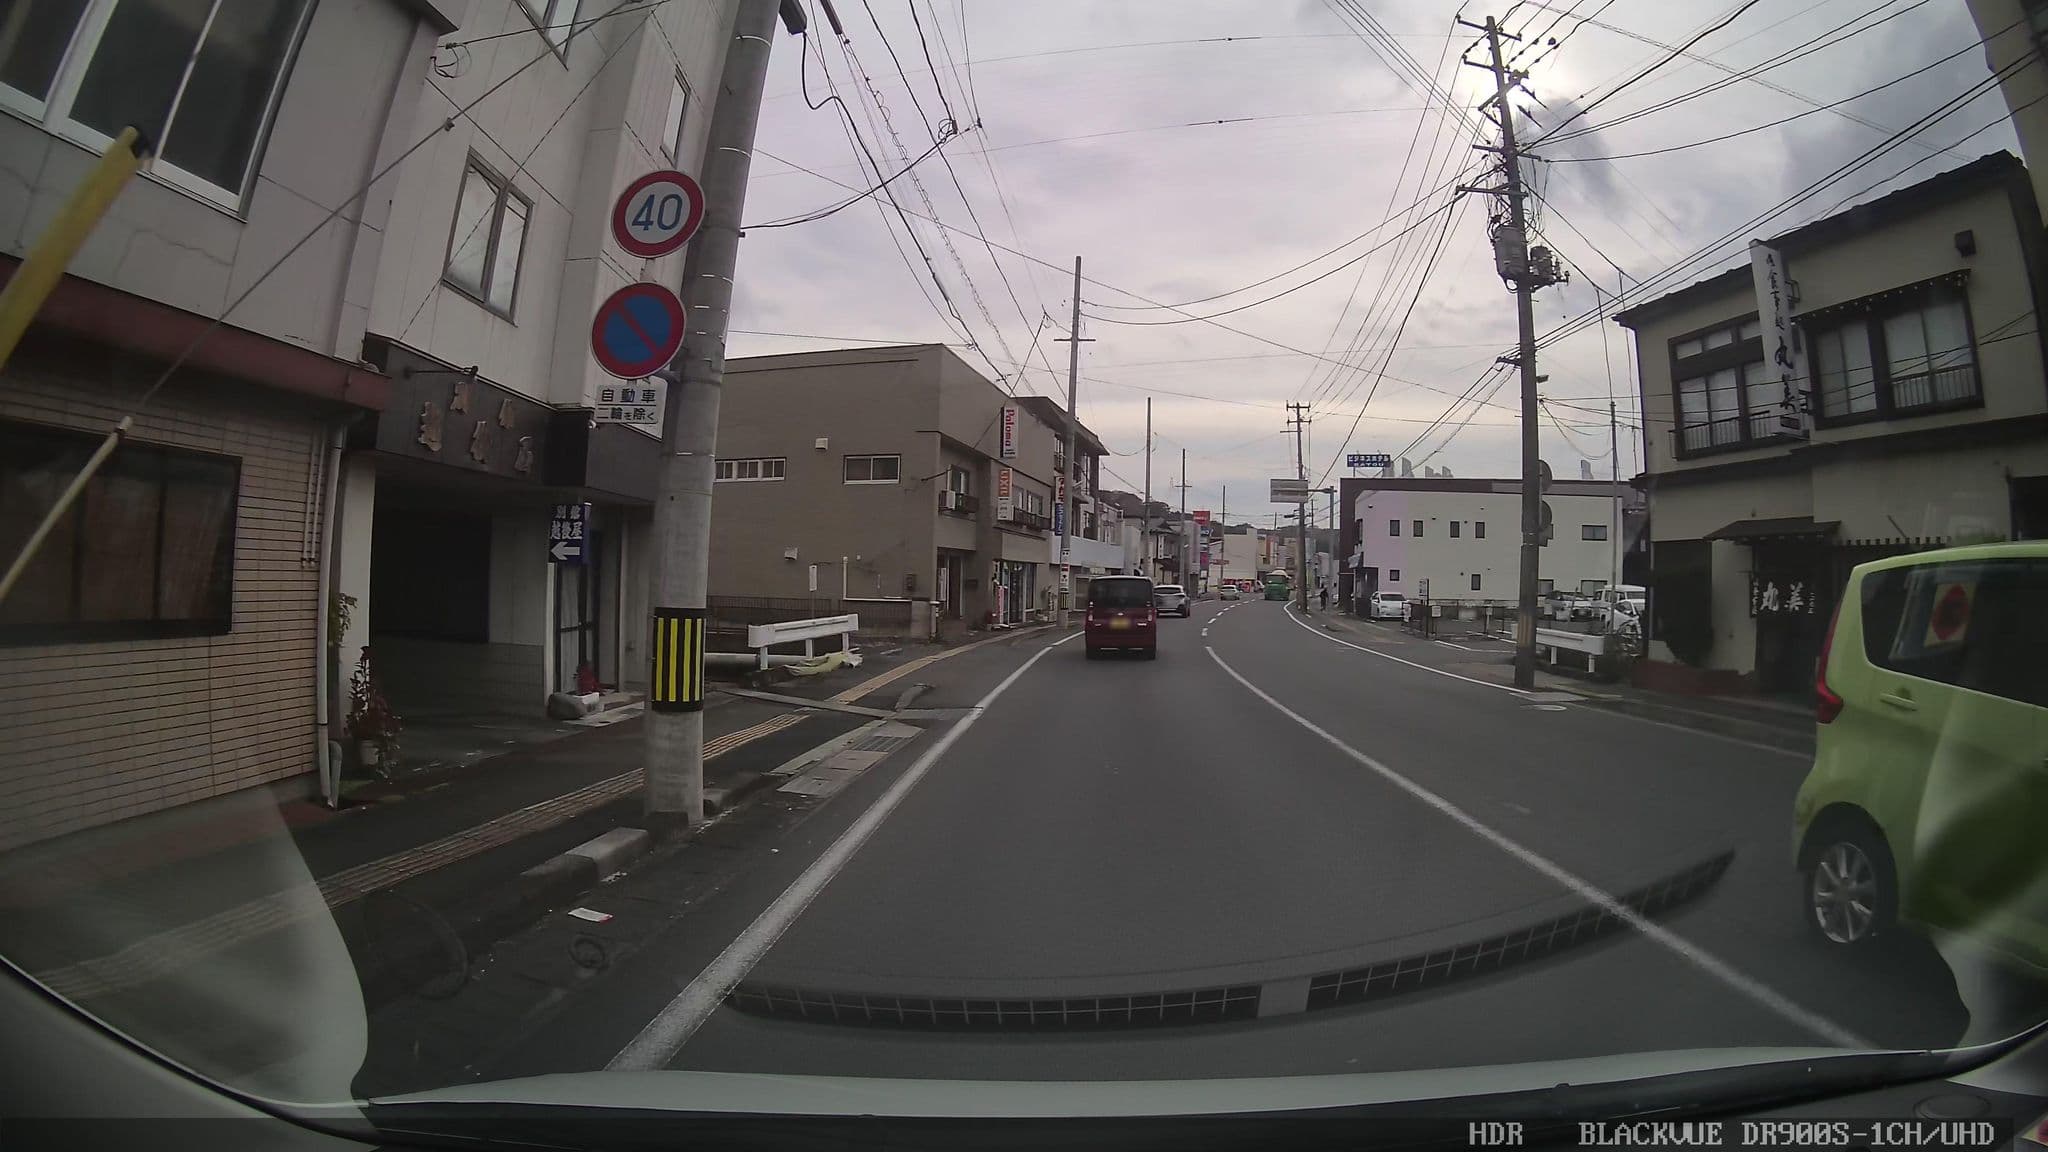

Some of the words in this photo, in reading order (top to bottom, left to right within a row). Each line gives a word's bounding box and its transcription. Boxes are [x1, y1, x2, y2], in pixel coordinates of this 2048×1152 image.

[632, 193, 683, 231] 40
[601, 388, 657, 403] 自動車
[596, 407, 655, 421] 二輪を除く
[1005, 409, 1015, 447] Paloma
[999, 470, 1009, 496] LIXIL
